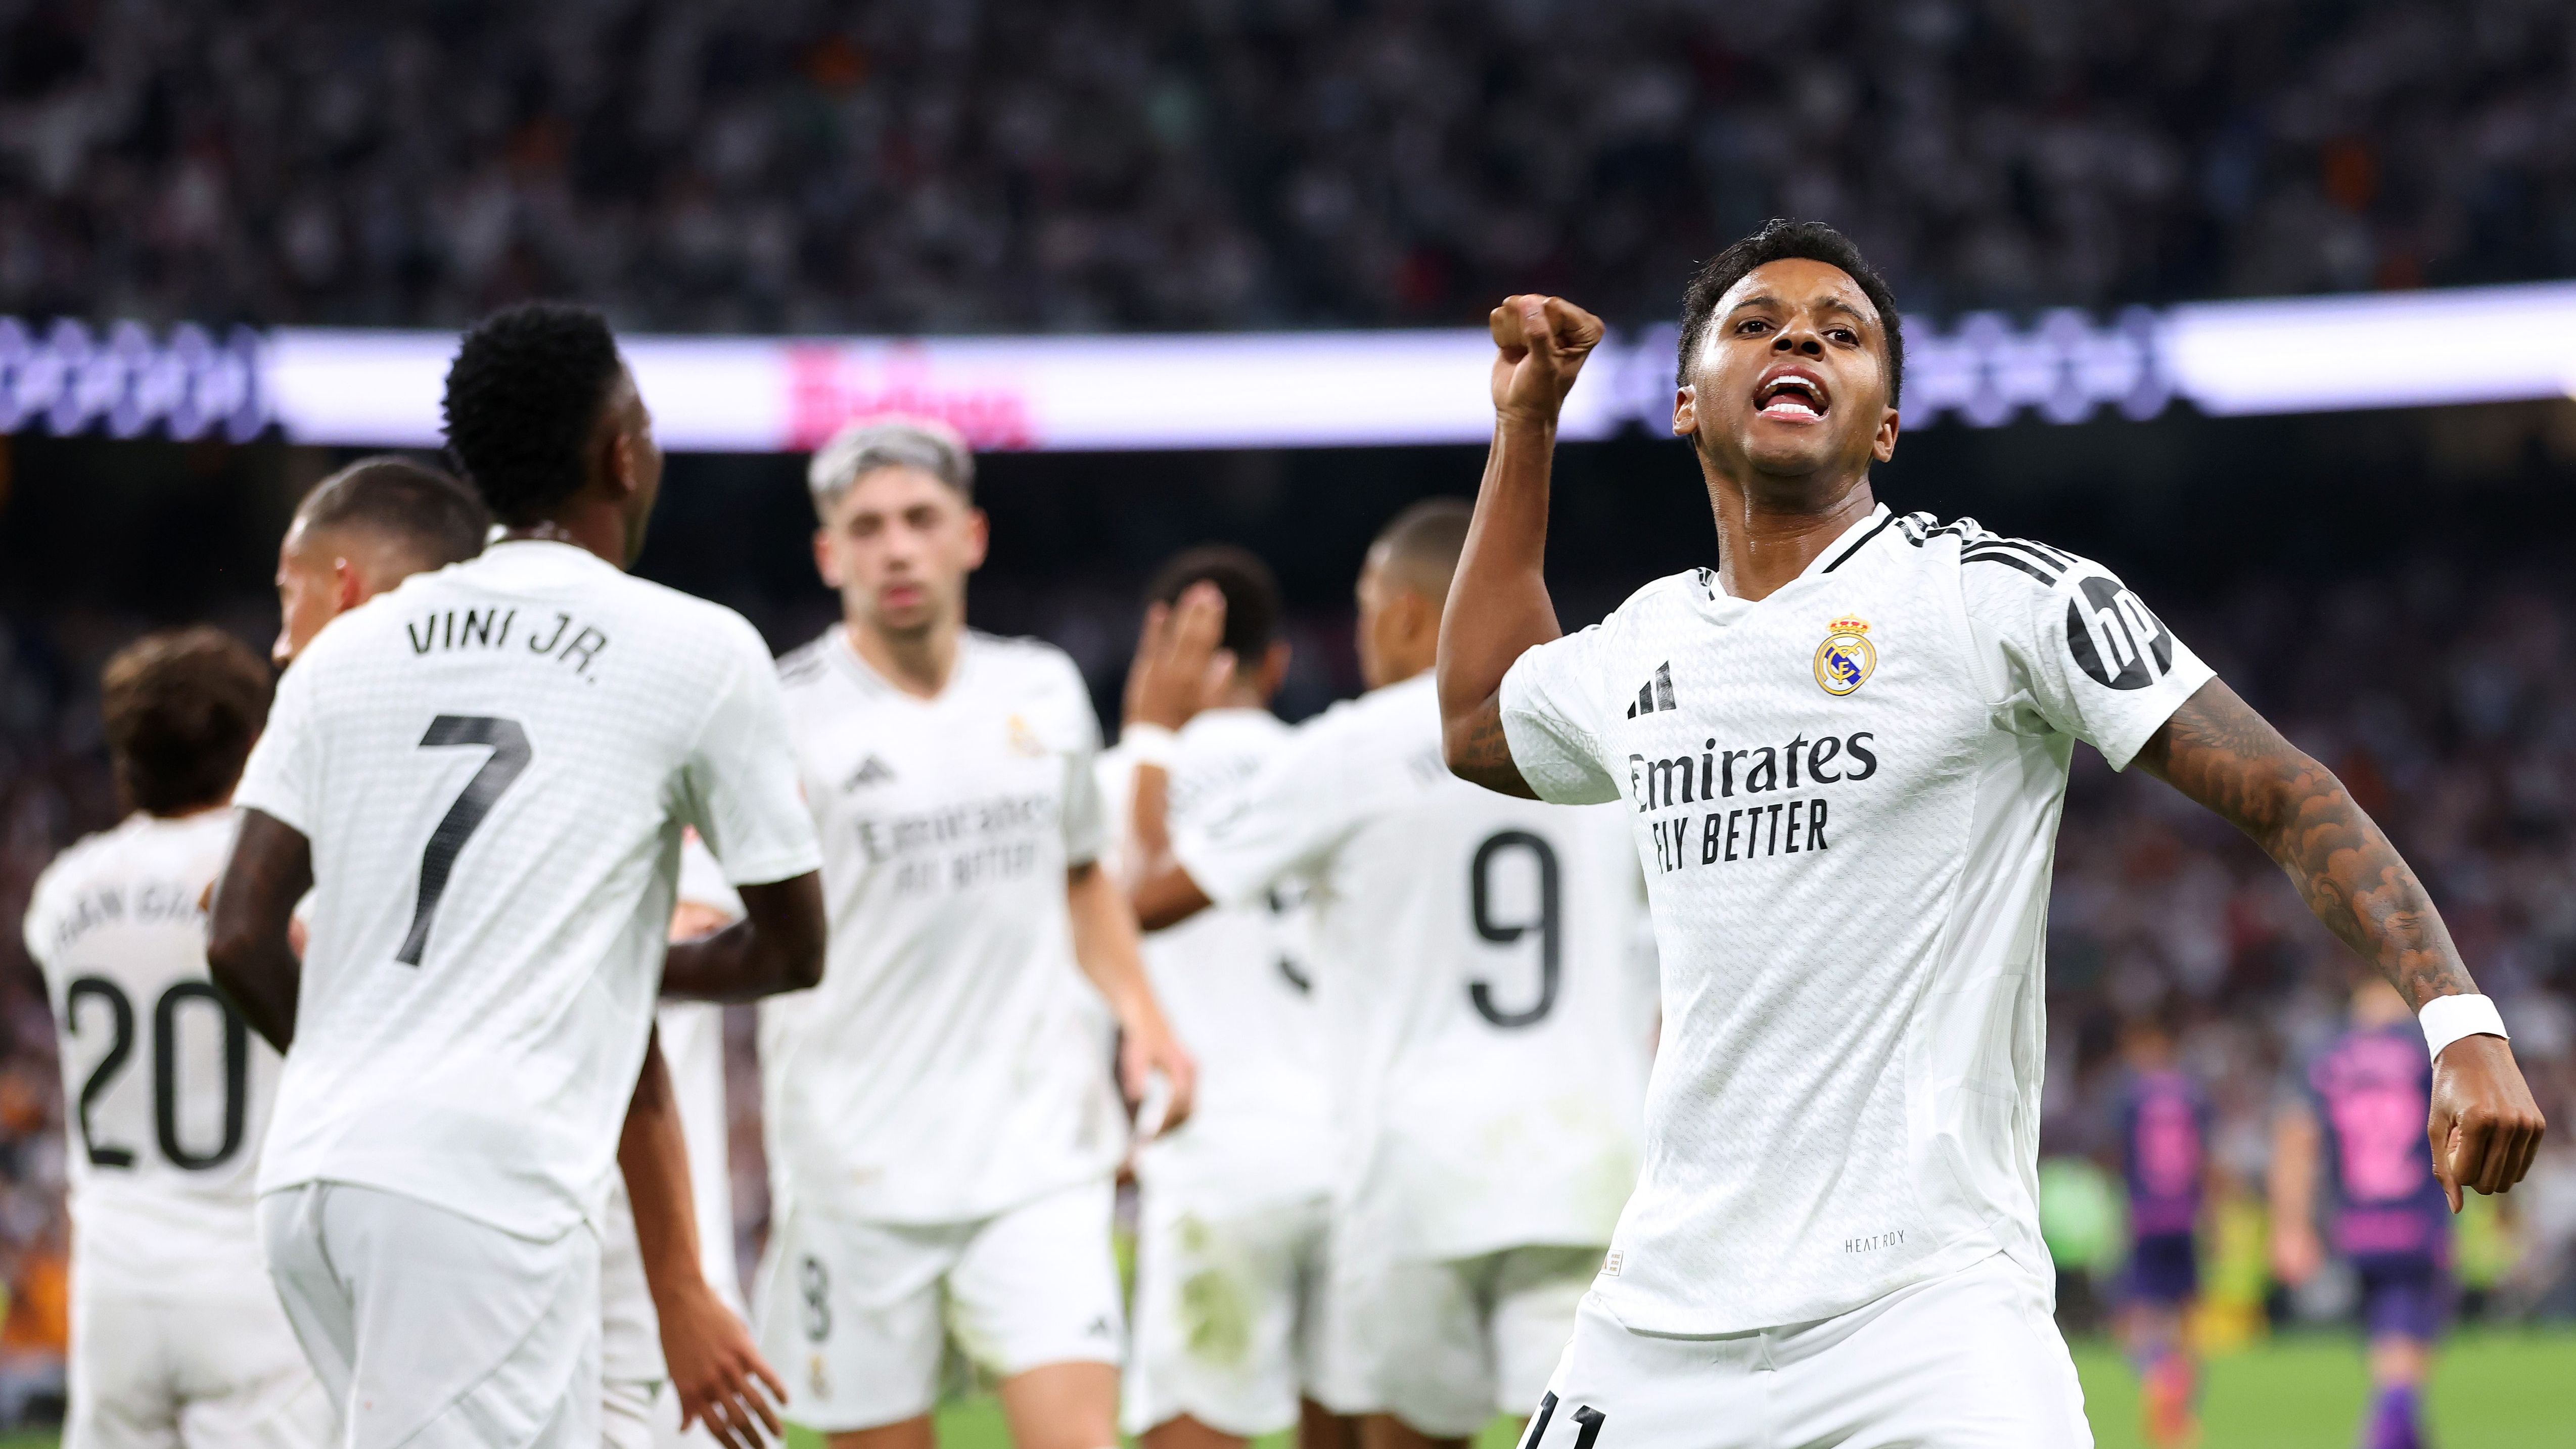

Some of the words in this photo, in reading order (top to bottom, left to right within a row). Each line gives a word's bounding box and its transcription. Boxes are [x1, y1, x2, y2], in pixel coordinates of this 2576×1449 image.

[407, 609, 516, 655] VINI
[529, 612, 609, 684] JR.
[2067, 577, 2172, 690] hp
[1629, 731, 1877, 814] Emirates
[395, 715, 533, 968] 7
[1652, 817, 1689, 874] FLY
[1702, 799, 1828, 866] BETTER
[1471, 830, 1559, 1028] 9
[68, 977, 247, 1172] 20
[1846, 1230, 1904, 1253] HEAT.RDY
